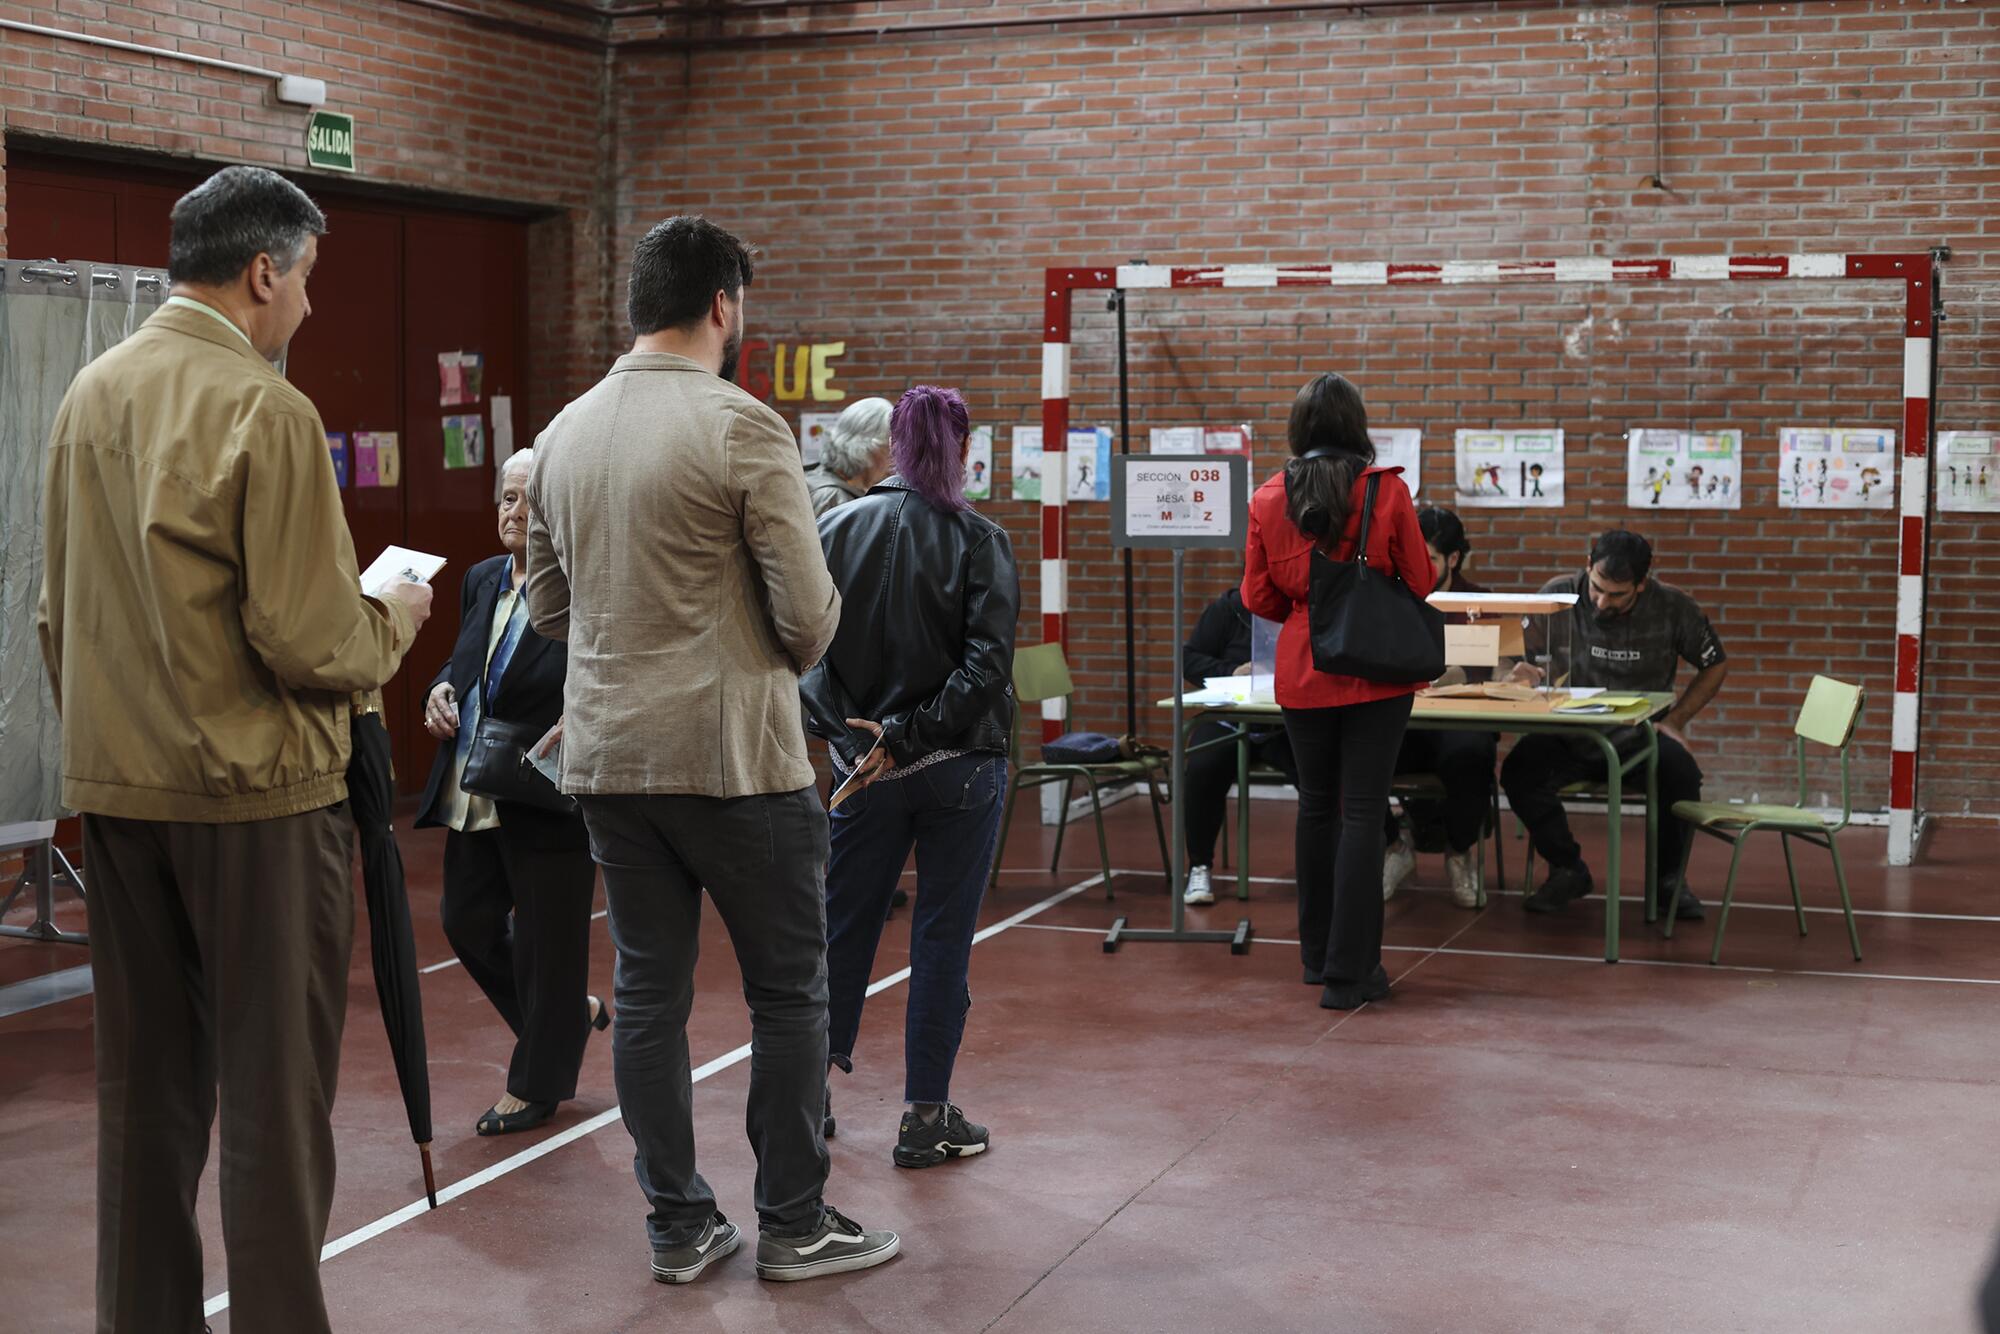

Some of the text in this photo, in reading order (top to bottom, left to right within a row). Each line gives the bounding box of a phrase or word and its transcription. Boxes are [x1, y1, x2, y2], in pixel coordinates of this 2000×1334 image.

[310, 125, 351, 156] SALIDA
[1136, 469, 1220, 482] SECCIÓN 038
[1156, 491, 1204, 503] MESA B
[1161, 511, 1173, 521] M
[1203, 511, 1213, 521] Z
